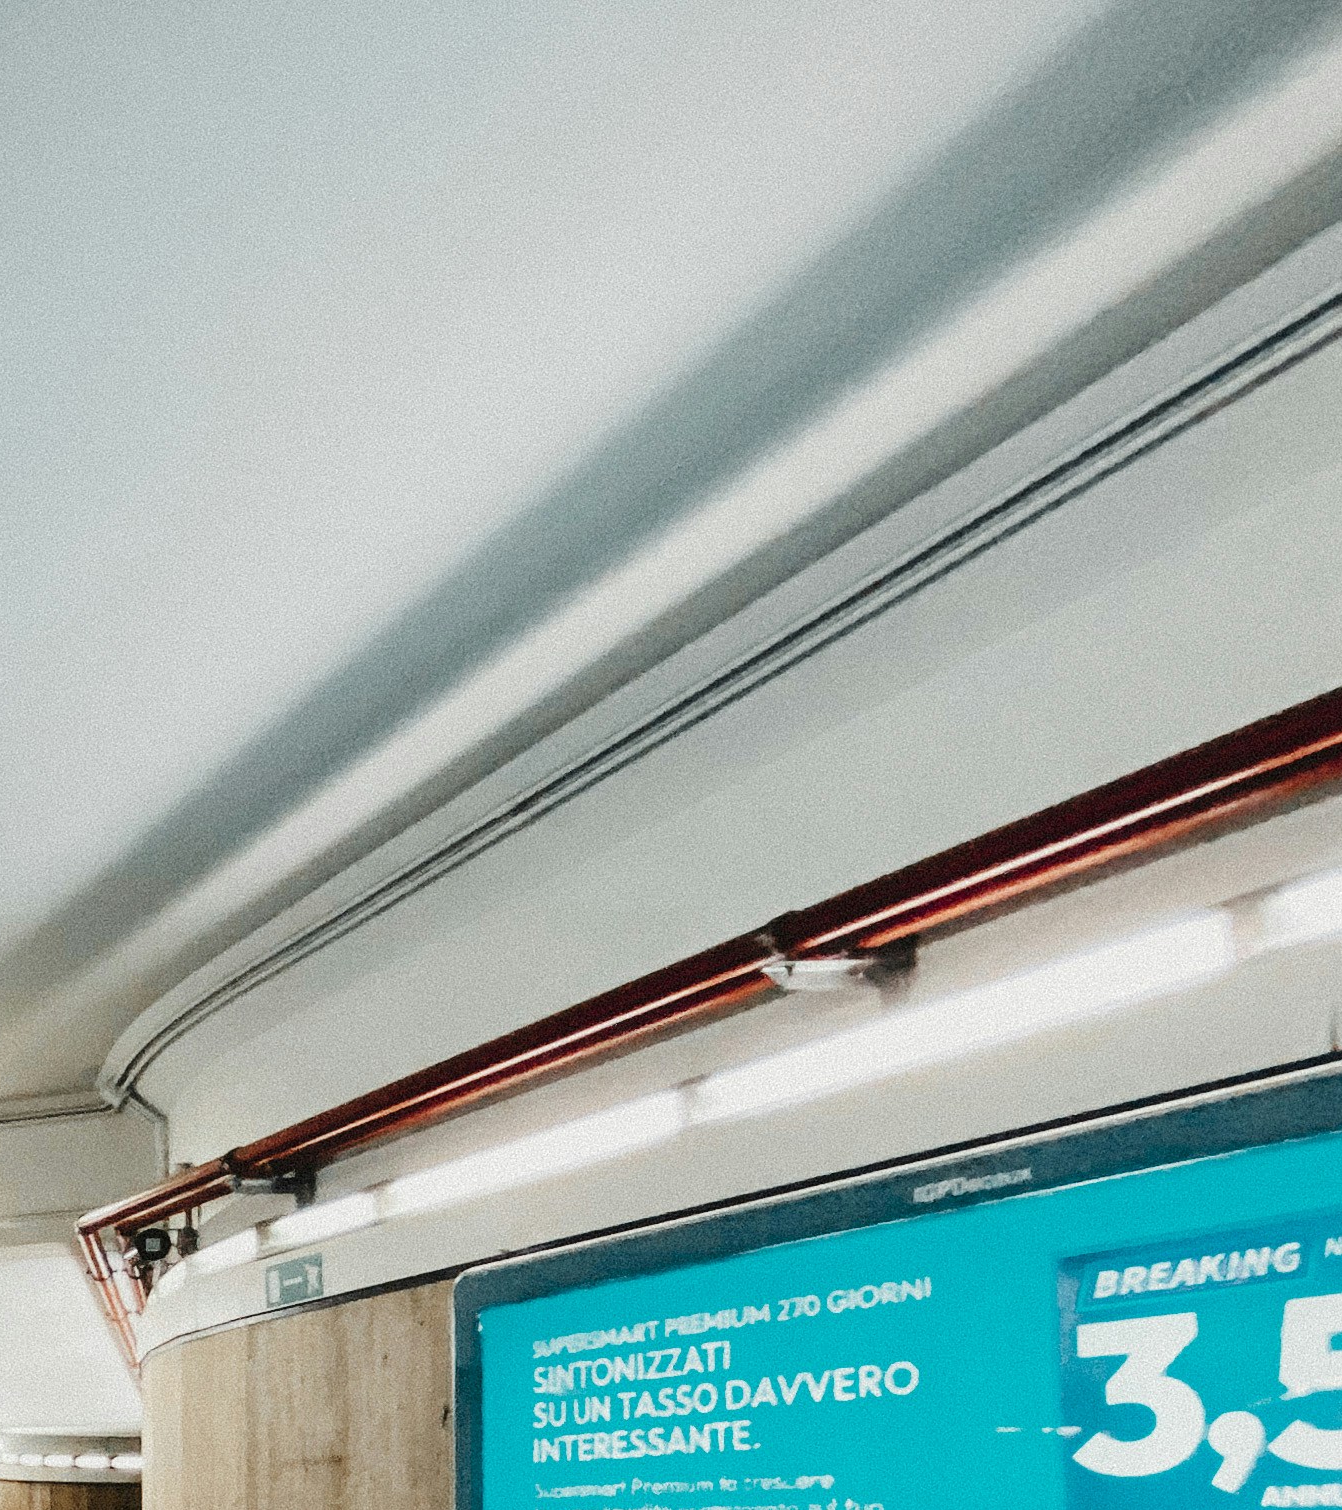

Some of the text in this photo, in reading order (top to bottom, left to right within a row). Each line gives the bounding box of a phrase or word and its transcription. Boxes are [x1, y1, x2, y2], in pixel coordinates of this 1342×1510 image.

[1092, 1241, 1302, 1299] BREAKING
[776, 1293, 822, 1323] 270
[826, 1276, 932, 1315] GIORNI
[532, 1340, 732, 1395] SINTONIZZATI
[532, 1360, 920, 1429] SU UN TASSO DAVVERO
[532, 1419, 762, 1464] INTERESSANTE.
